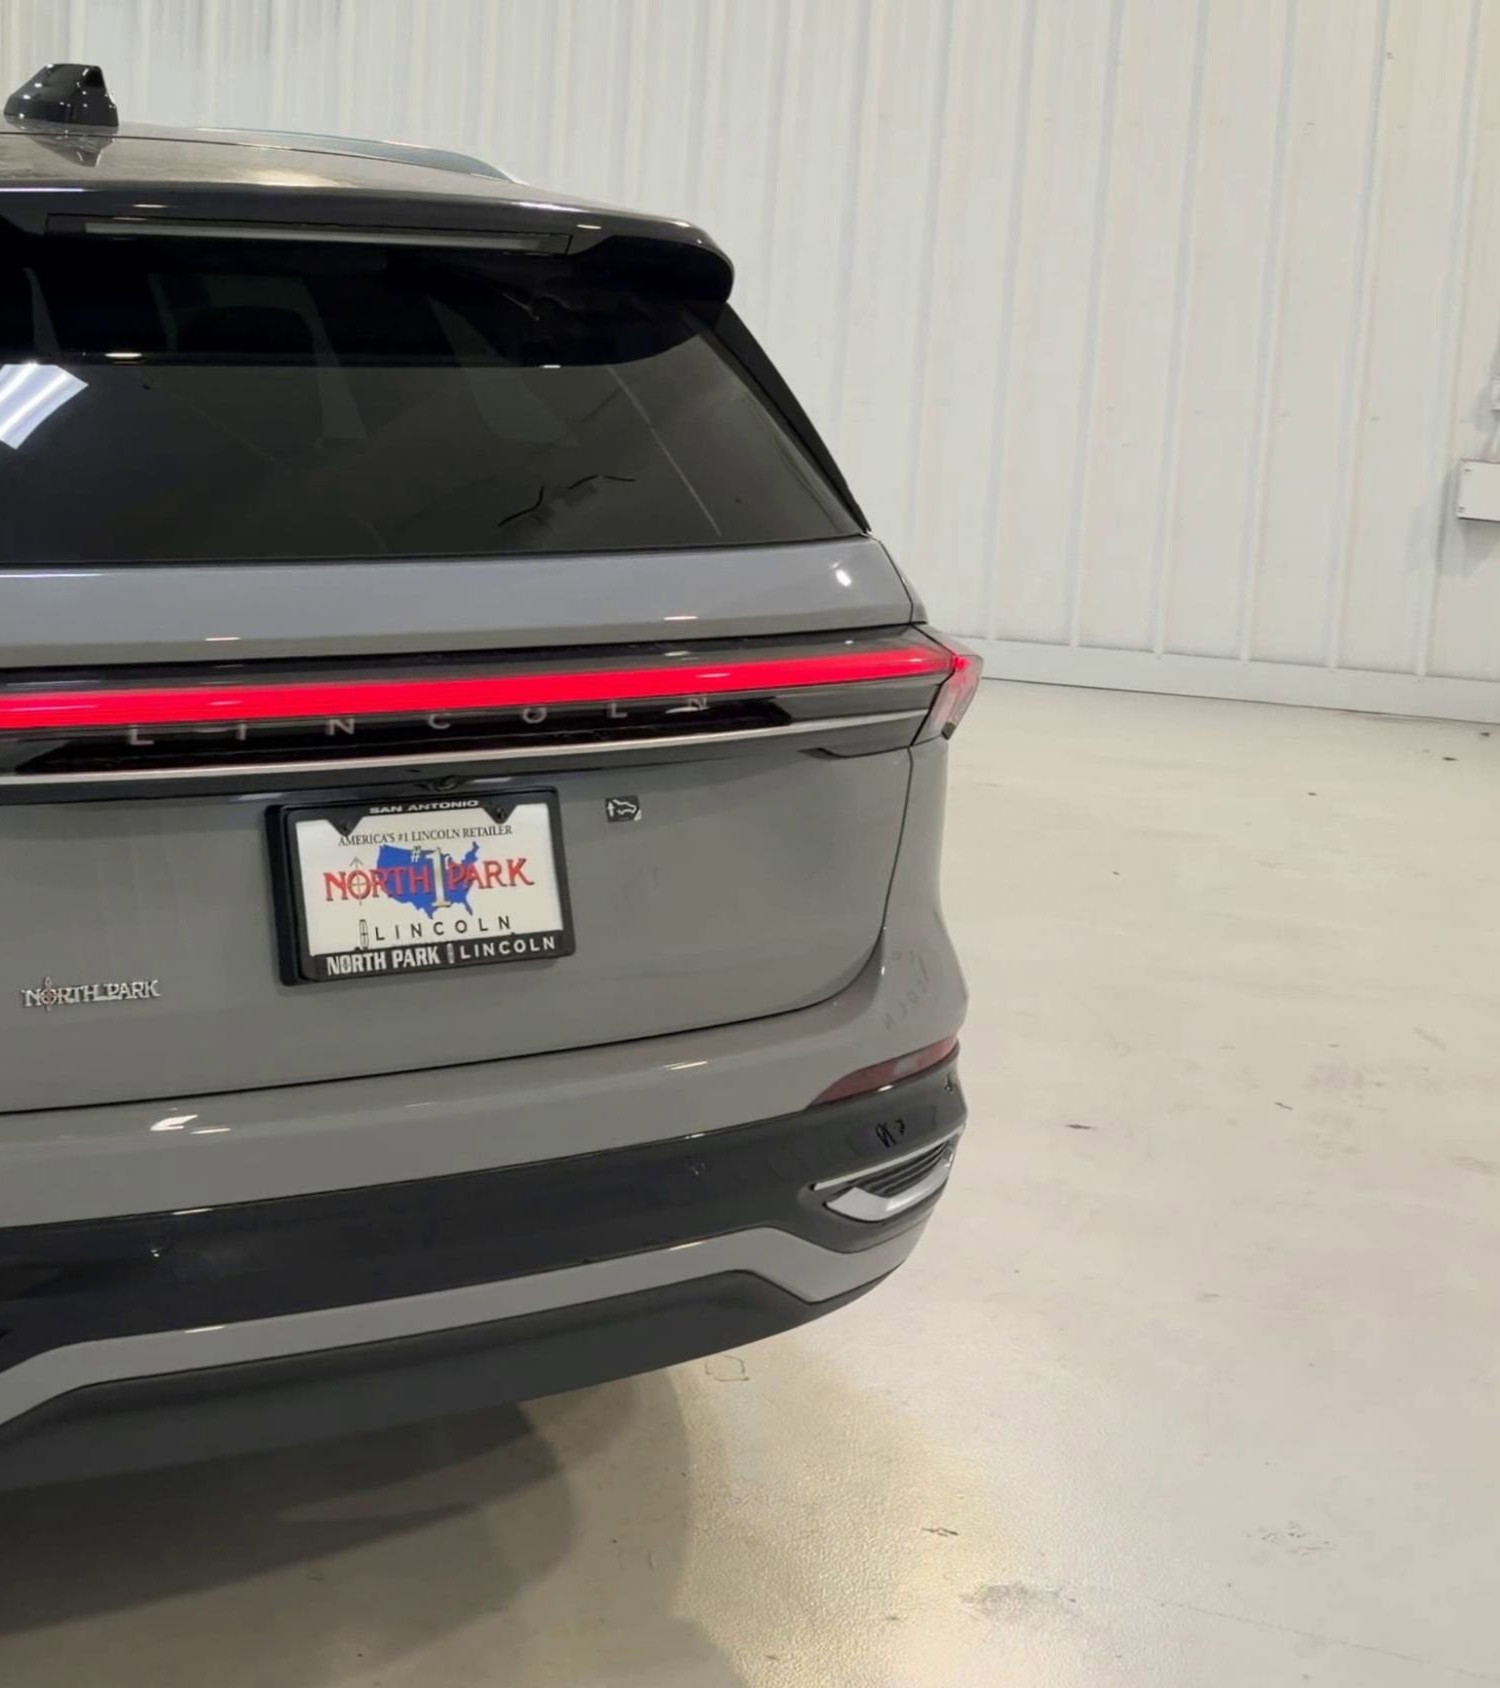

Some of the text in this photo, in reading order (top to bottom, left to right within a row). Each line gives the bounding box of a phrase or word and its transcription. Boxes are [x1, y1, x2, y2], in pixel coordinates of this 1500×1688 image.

[128, 694, 709, 746] LINCOLN
[369, 799, 479, 815] SAN ANTONIO
[338, 824, 512, 847] AMERICA'S #1 LINCOLN RETAILER
[323, 857, 535, 902] NORTH PARK
[374, 915, 511, 942] LINCOLN
[326, 935, 556, 976] NORTH PARK LINCOLN
